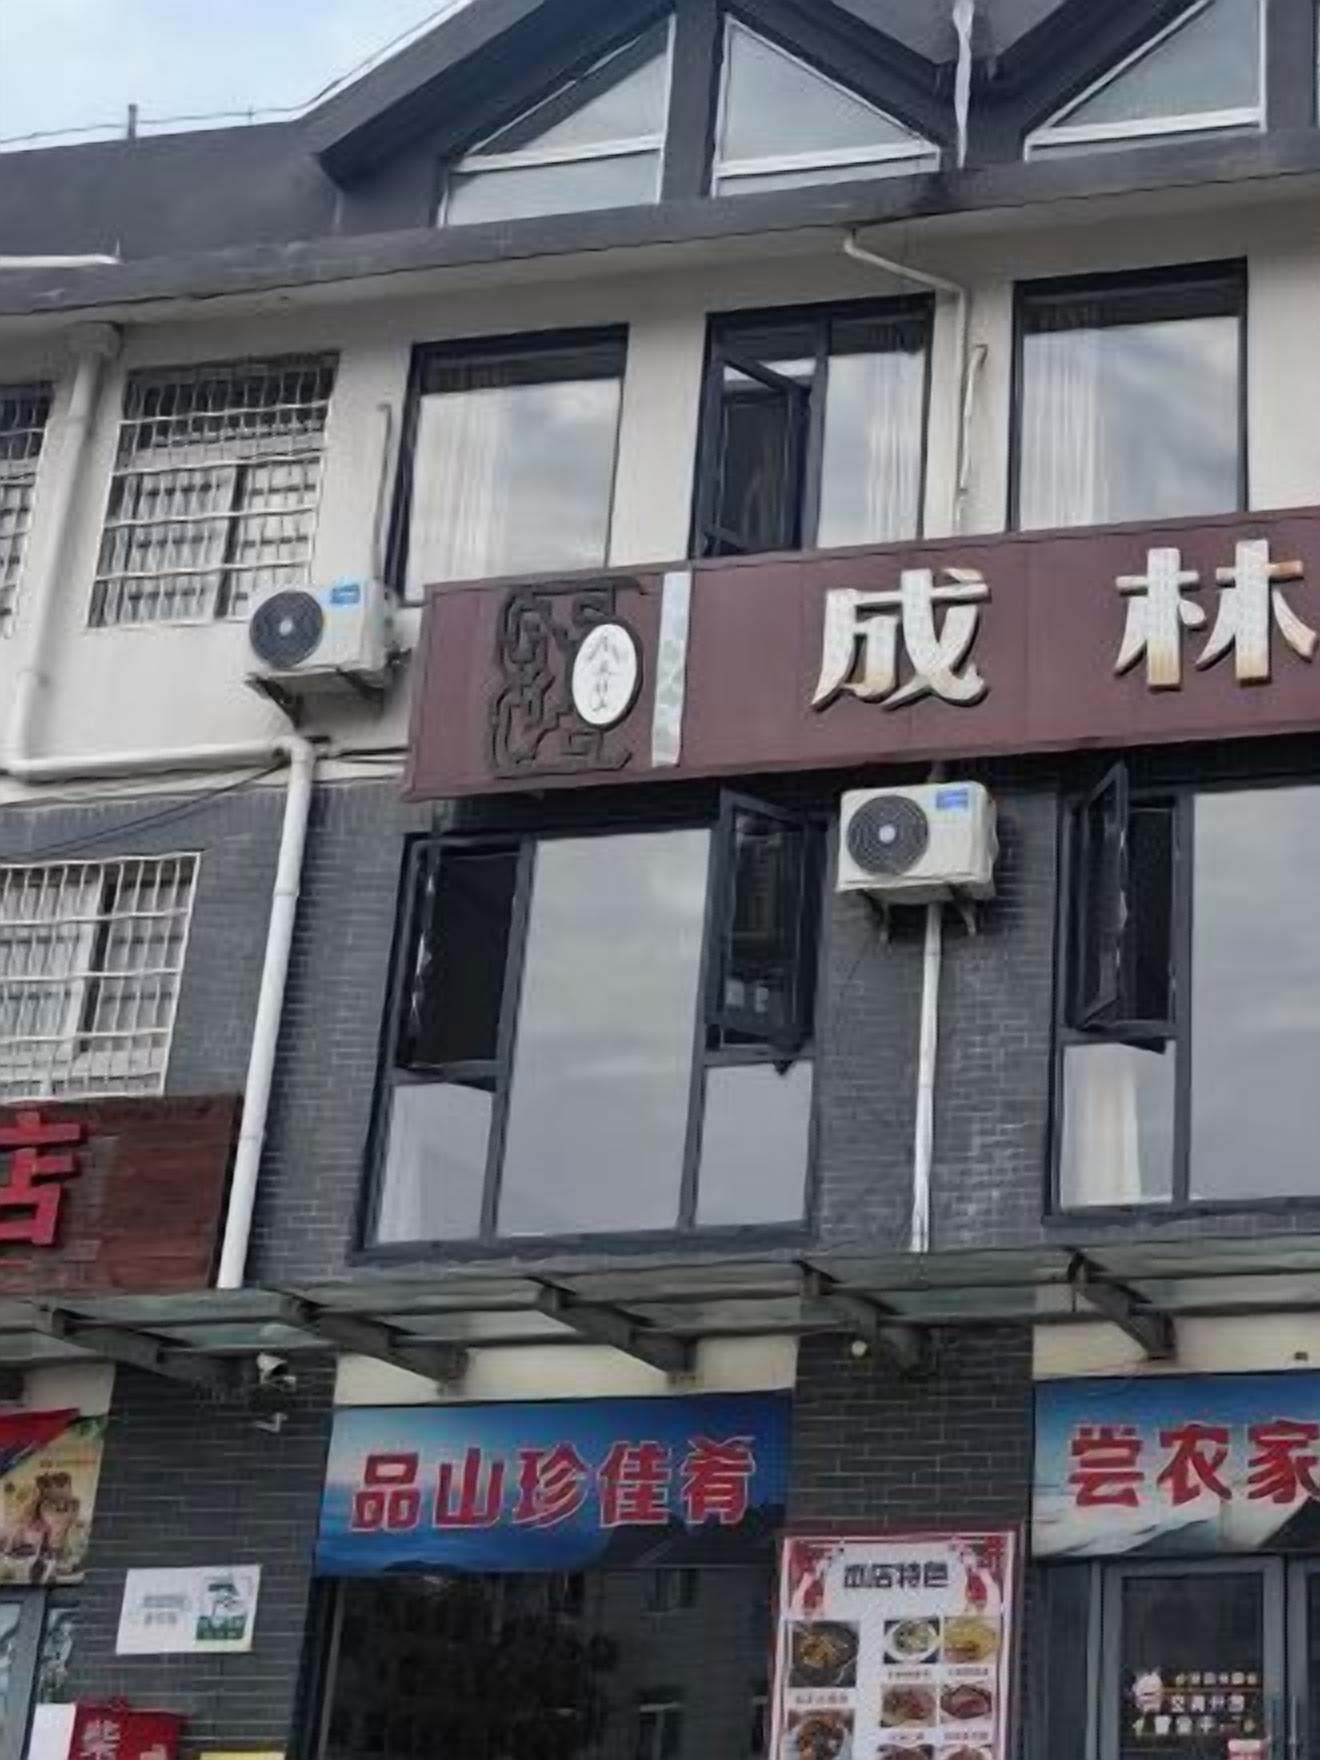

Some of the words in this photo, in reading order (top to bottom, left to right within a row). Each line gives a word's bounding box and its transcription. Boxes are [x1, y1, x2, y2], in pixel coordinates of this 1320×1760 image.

[350, 1432, 757, 1533] 品山珍佳肴
